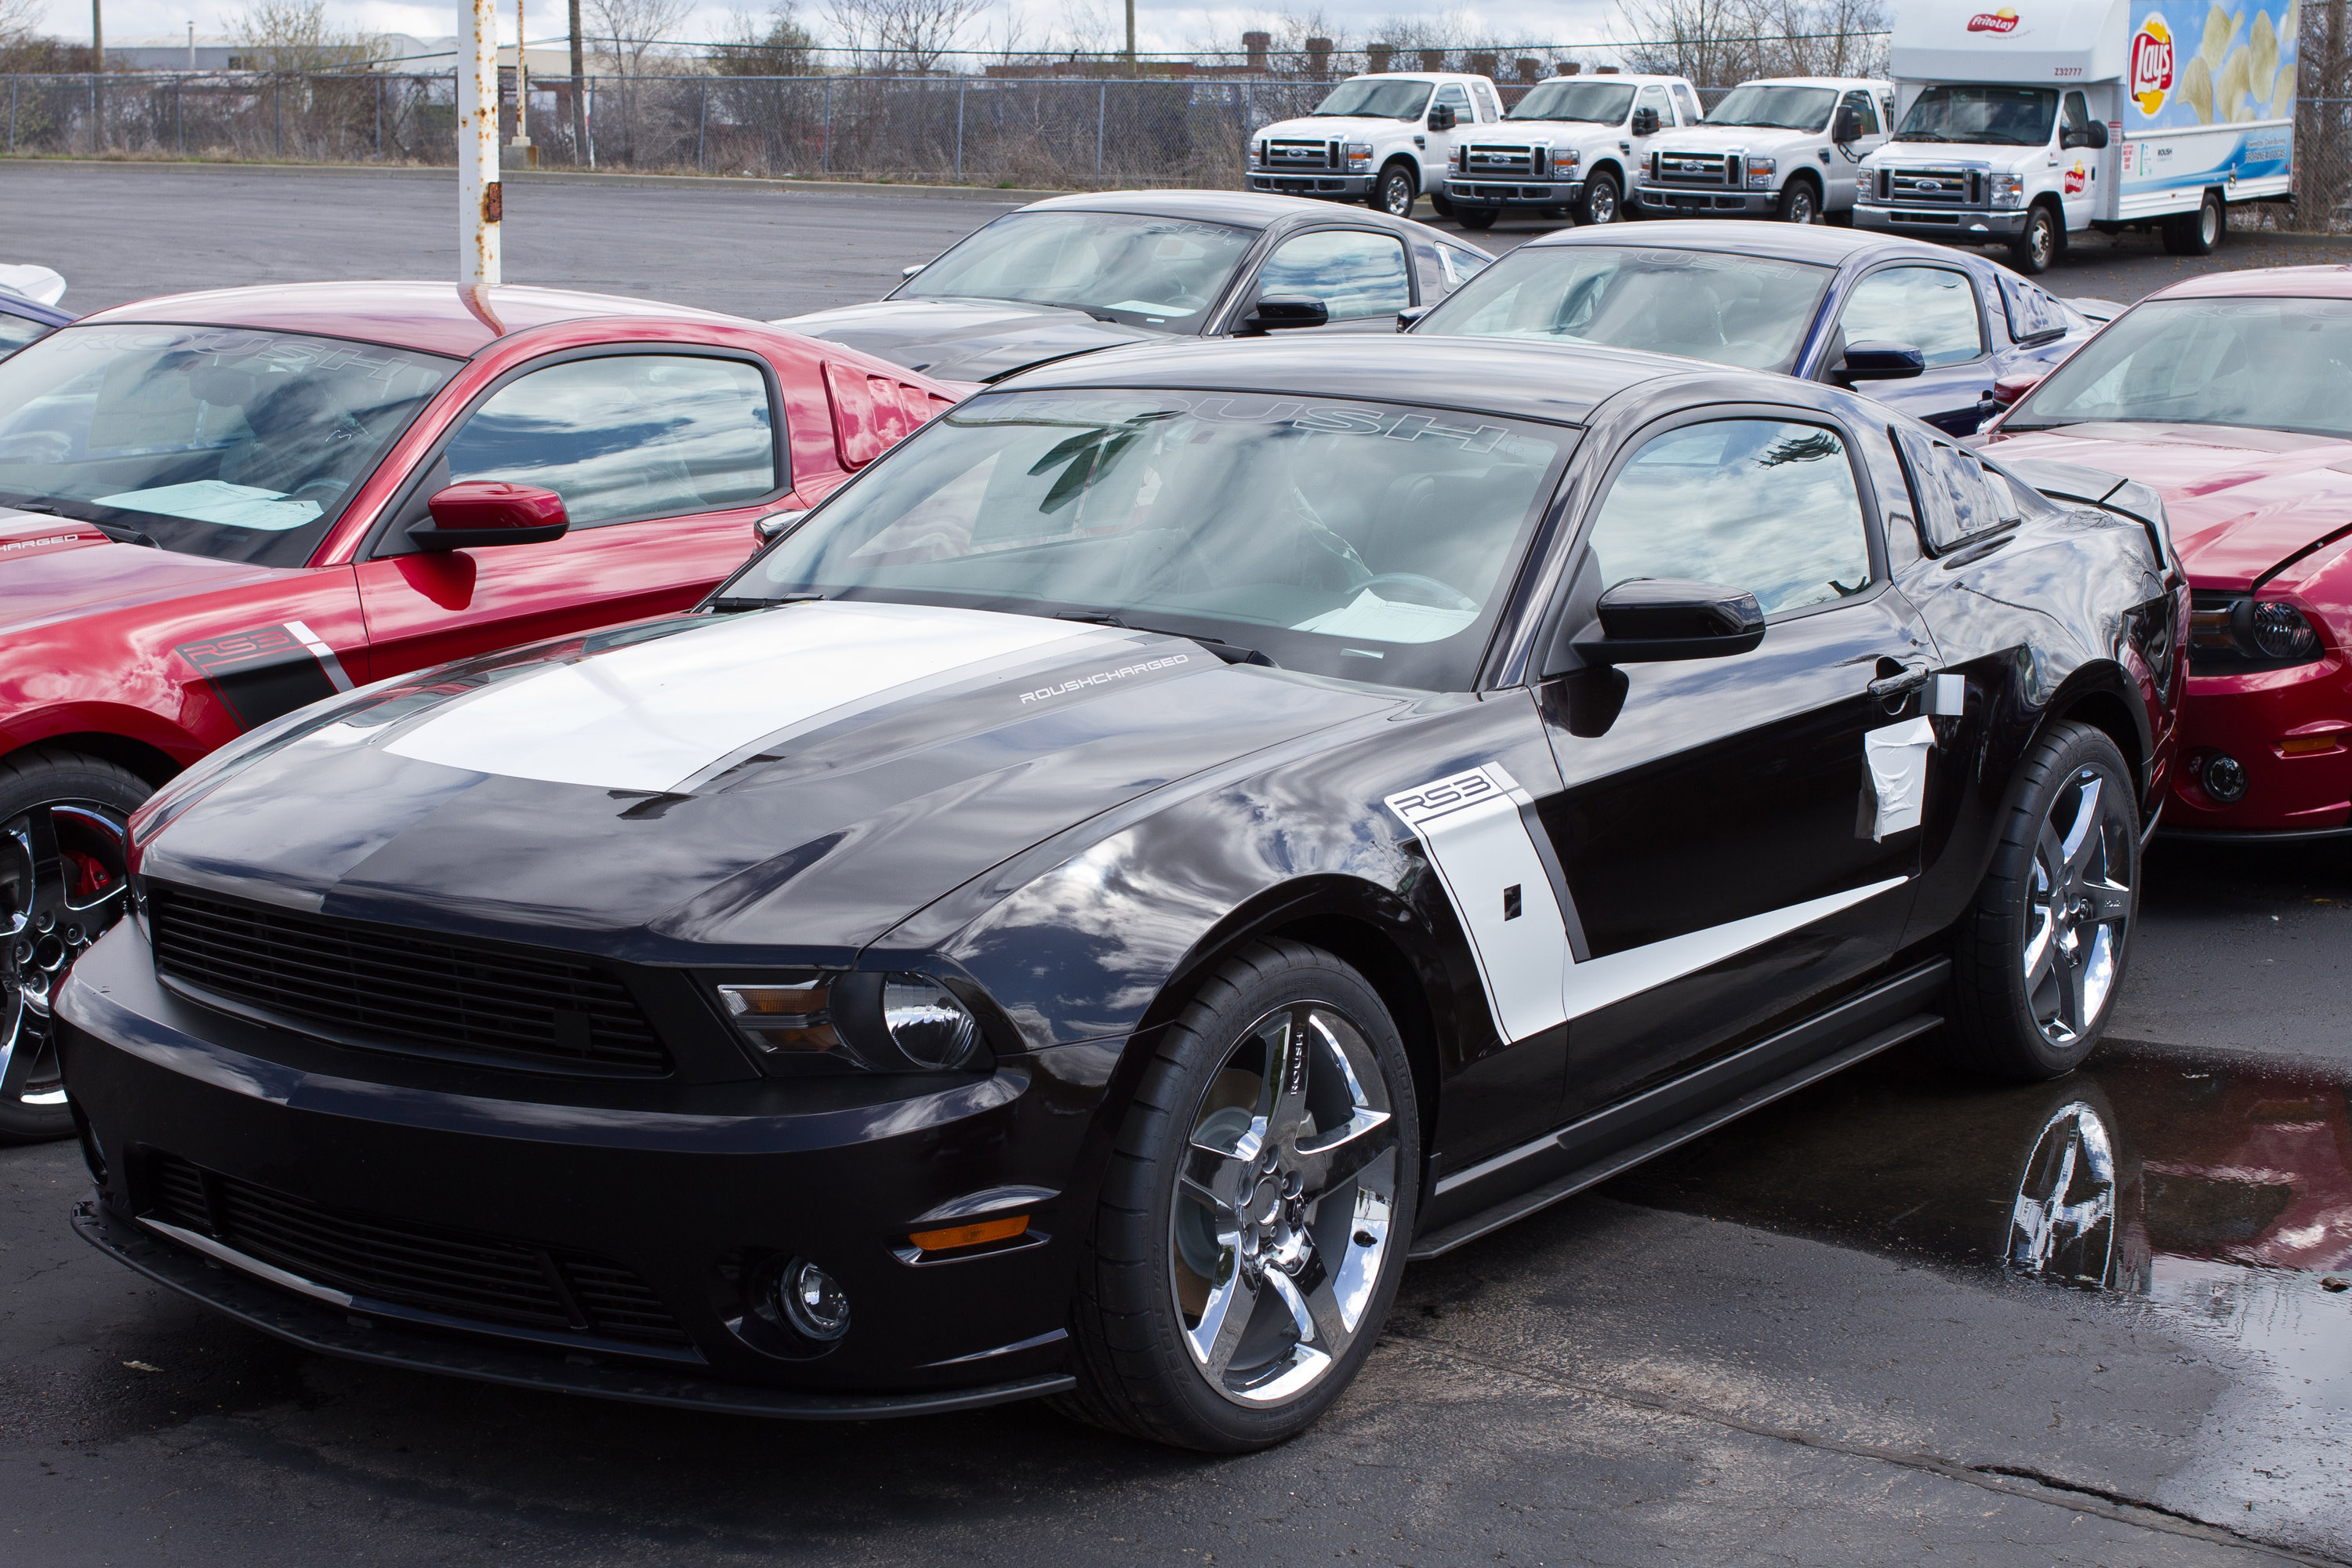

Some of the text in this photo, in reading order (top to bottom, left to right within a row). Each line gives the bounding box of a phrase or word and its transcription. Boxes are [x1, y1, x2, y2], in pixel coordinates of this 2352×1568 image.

[2054, 67, 2082, 76] Z32777
[2133, 35, 2170, 96] Lay's
[2245, 148, 2286, 163] PROPANE AUTOGAS
[1526, 249, 1801, 281] ROUSH
[56, 331, 412, 383] ROUSH
[989, 395, 1511, 454] ROUSH
[183, 630, 290, 662] RS3
[1018, 654, 1189, 705] ROUSHCHARGED
[1392, 775, 1491, 818] RS3
[1290, 1031, 1304, 1095] ROUSH
